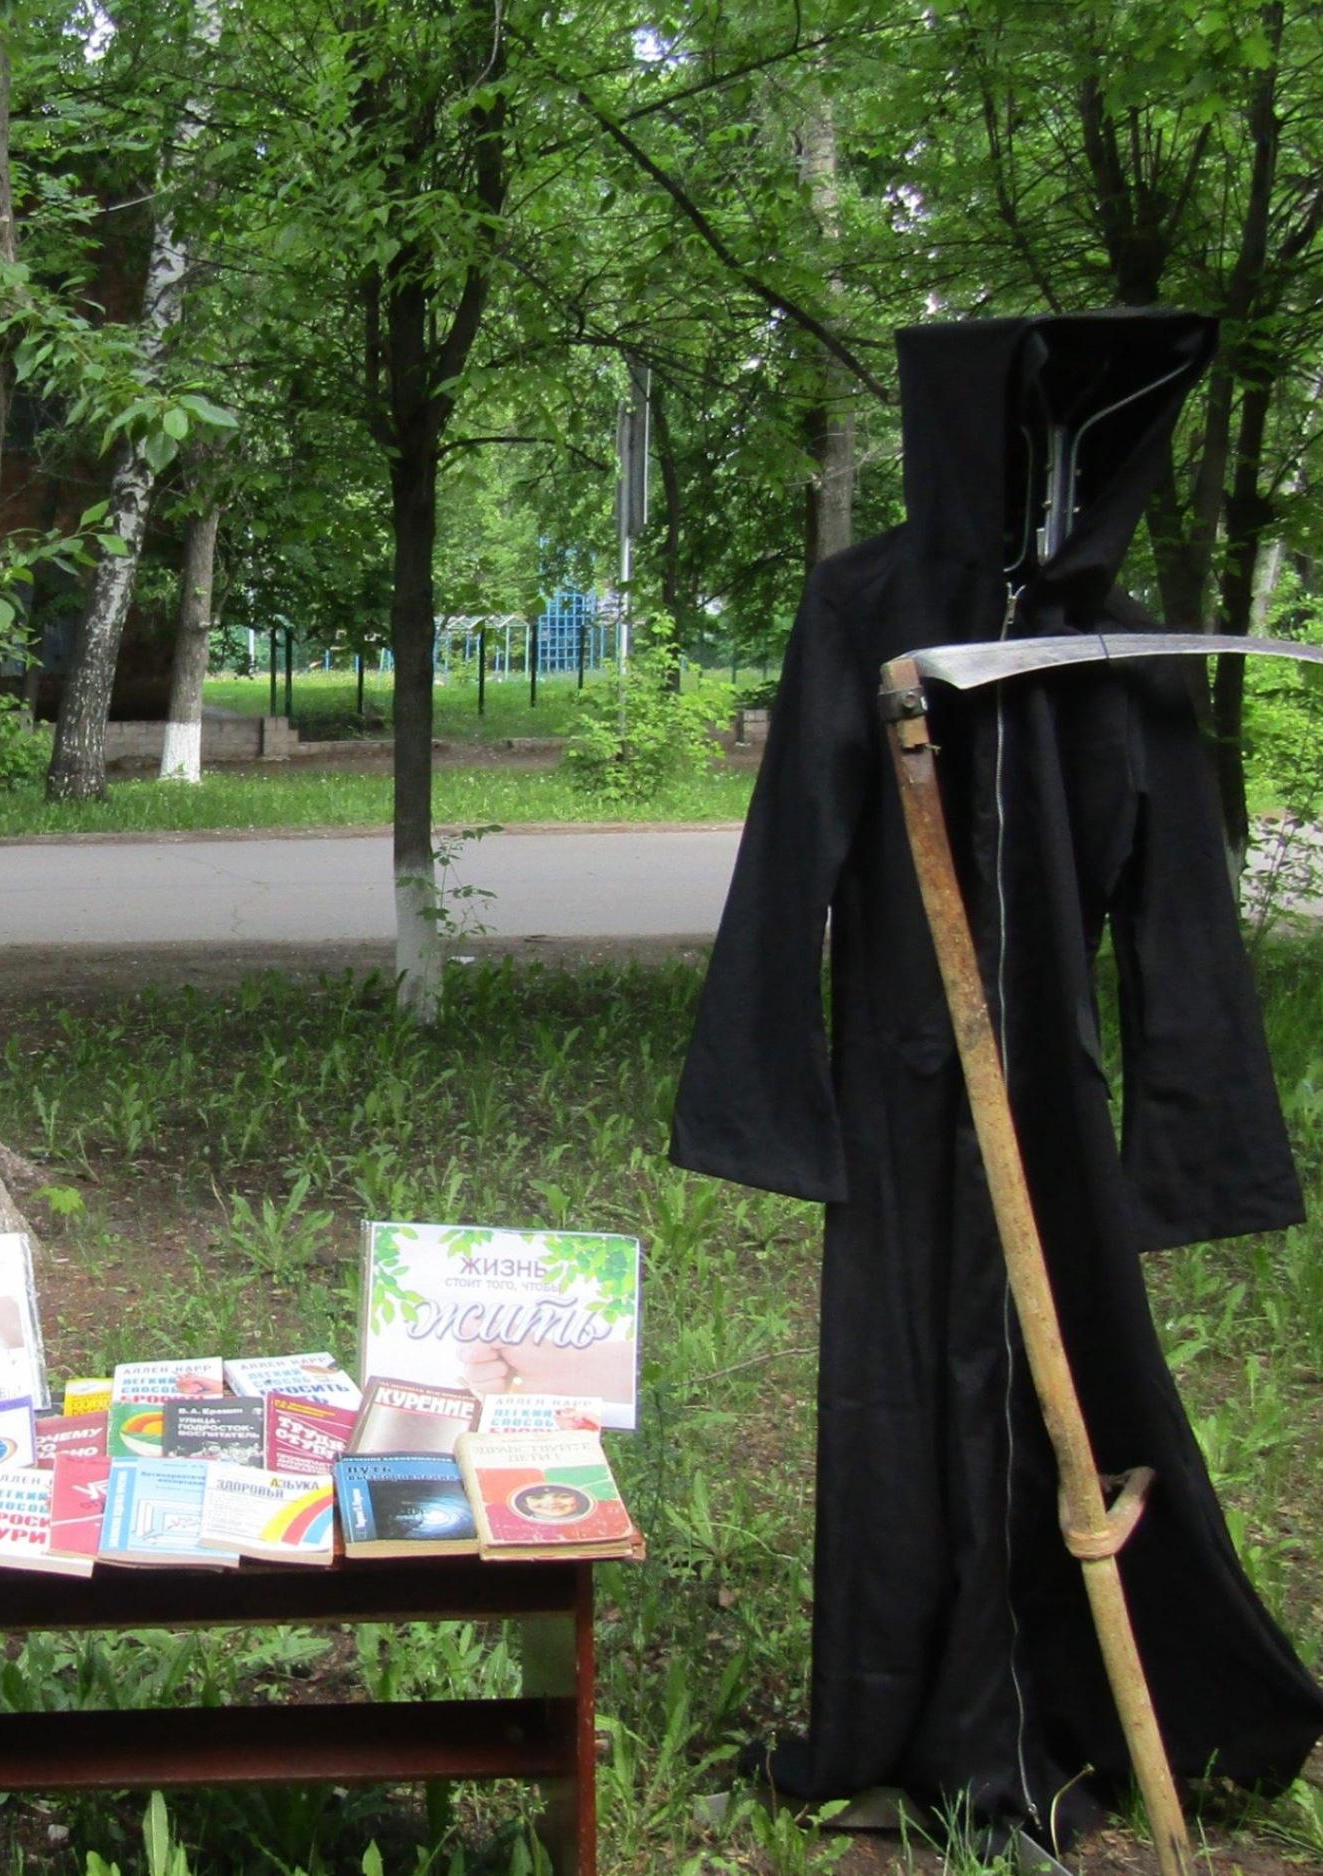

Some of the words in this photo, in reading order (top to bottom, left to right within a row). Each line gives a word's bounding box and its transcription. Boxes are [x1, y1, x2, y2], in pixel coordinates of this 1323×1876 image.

[460, 1257, 547, 1278] ЖИЗНЬ
[445, 1278, 482, 1289] СТОИТ
[123, 1366, 169, 1376] АЛЛЕН
[374, 1386, 475, 1420] КУРЕНИЕ
[178, 1423, 255, 1432] ПОДРОСТОК-
[36, 1427, 103, 1444] ОЧЕМУ
[216, 1478, 284, 1499] ЗДОРОВЬЯ
[270, 1477, 320, 1491] АЗБУКА
